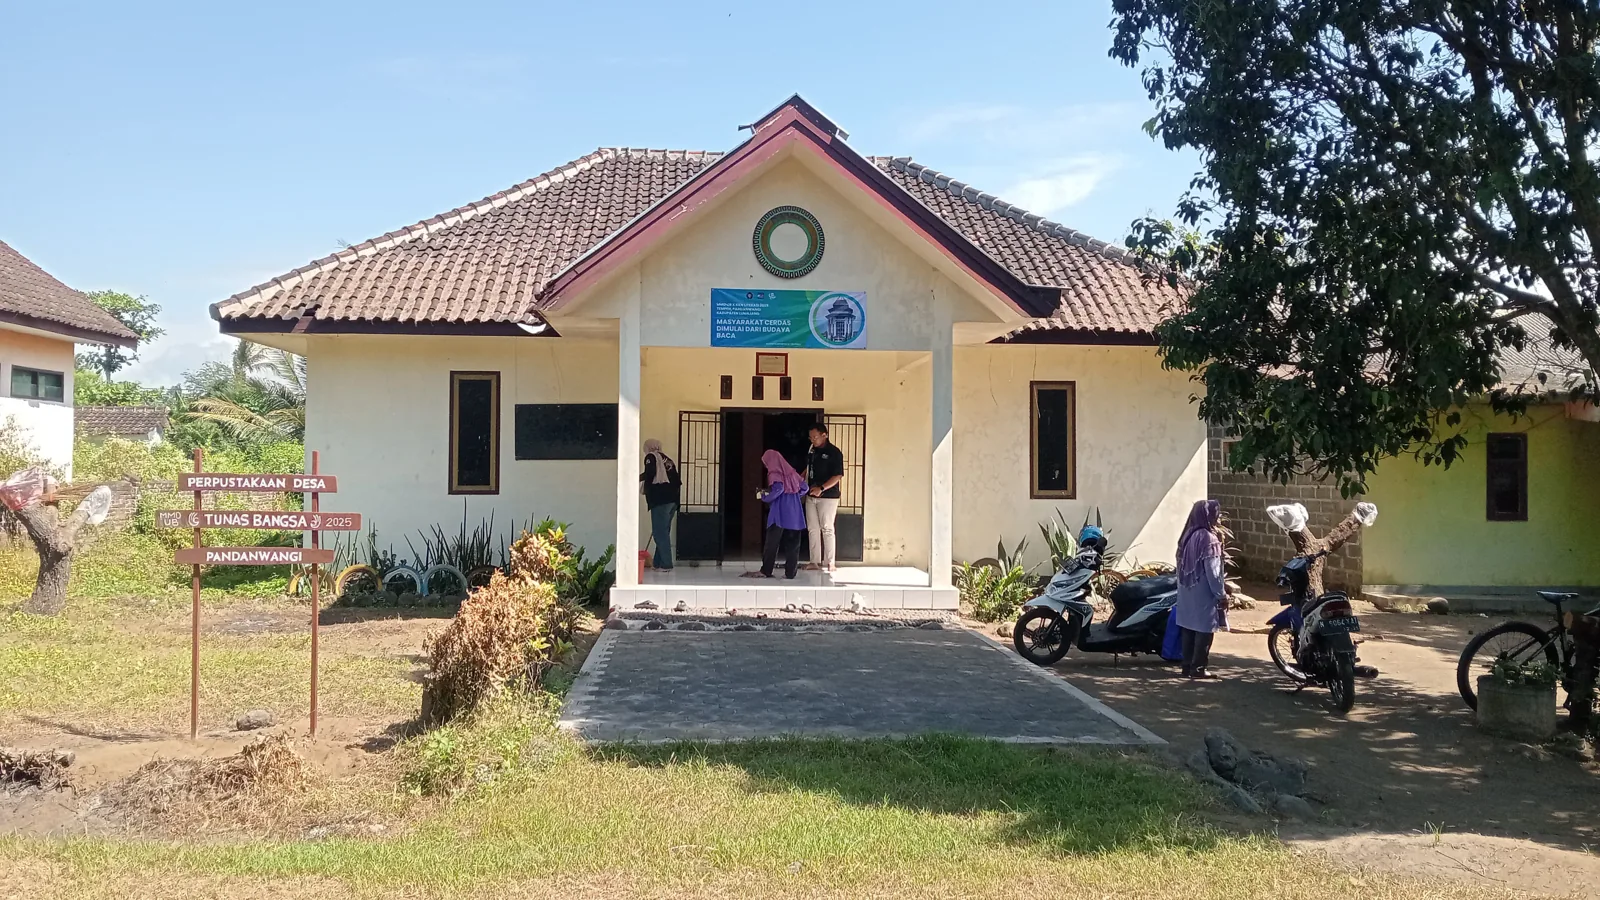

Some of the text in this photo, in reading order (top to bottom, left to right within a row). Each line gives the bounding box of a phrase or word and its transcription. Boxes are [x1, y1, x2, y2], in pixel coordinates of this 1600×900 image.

[187, 477, 326, 489] PERPUSTAKAAN DESA
[159, 512, 182, 520] MMD
[204, 514, 308, 528] TUNAS BANGSA
[325, 517, 352, 527] 2025
[206, 551, 302, 562] PANDANWANGI
